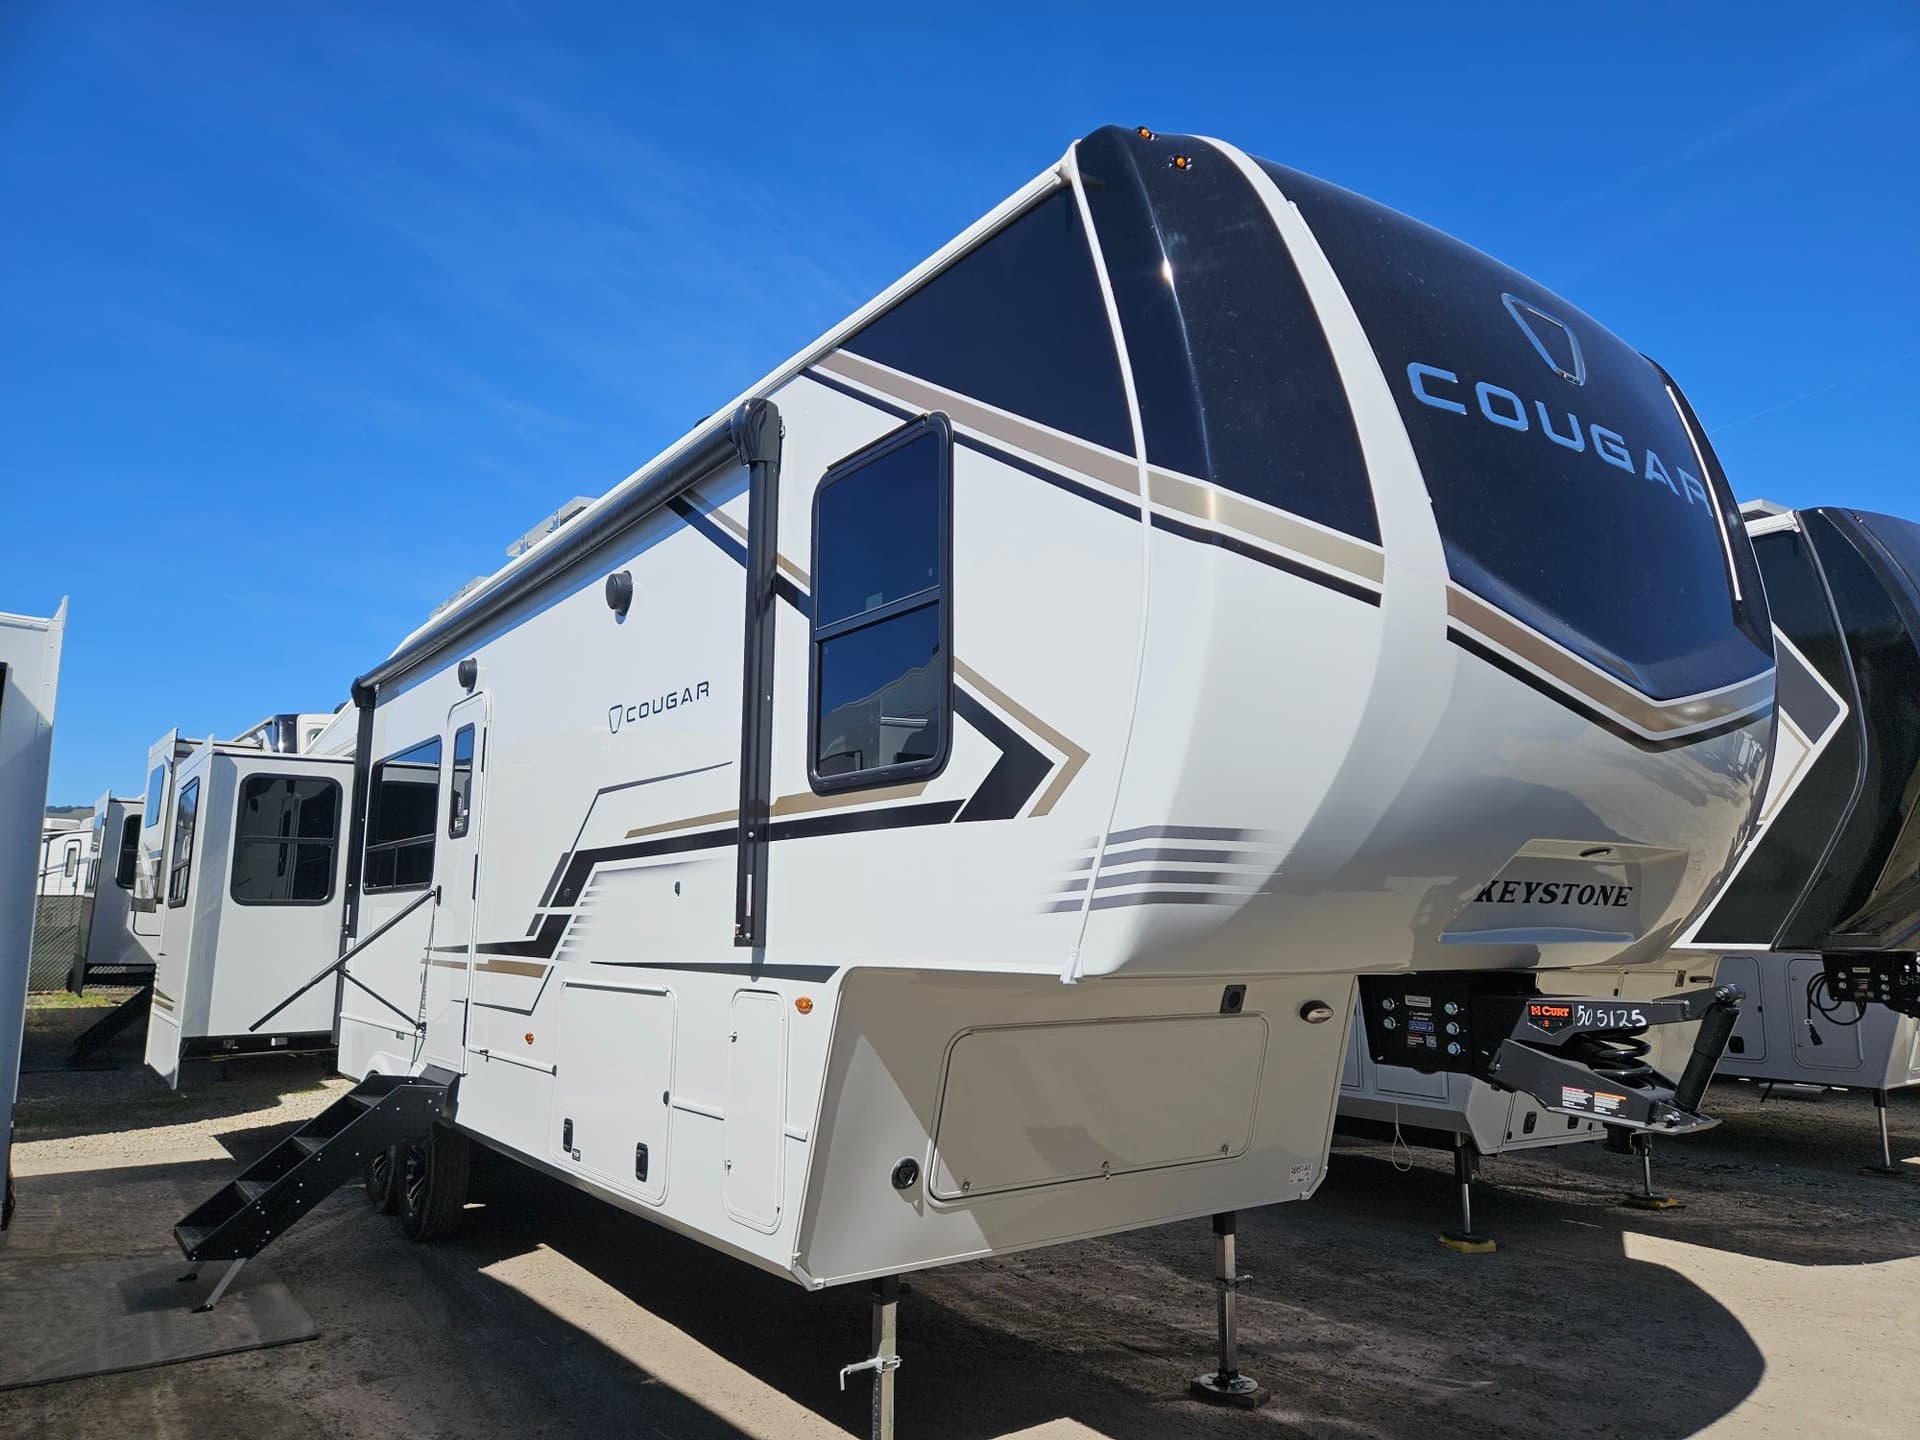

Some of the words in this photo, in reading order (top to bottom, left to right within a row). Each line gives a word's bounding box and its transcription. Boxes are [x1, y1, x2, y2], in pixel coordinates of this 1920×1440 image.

[1406, 361, 1714, 518] COUGAR
[626, 681, 709, 722] COUGAR
[1474, 880, 1633, 907] KEYSTONE
[1542, 1005, 1569, 1017] CURT
